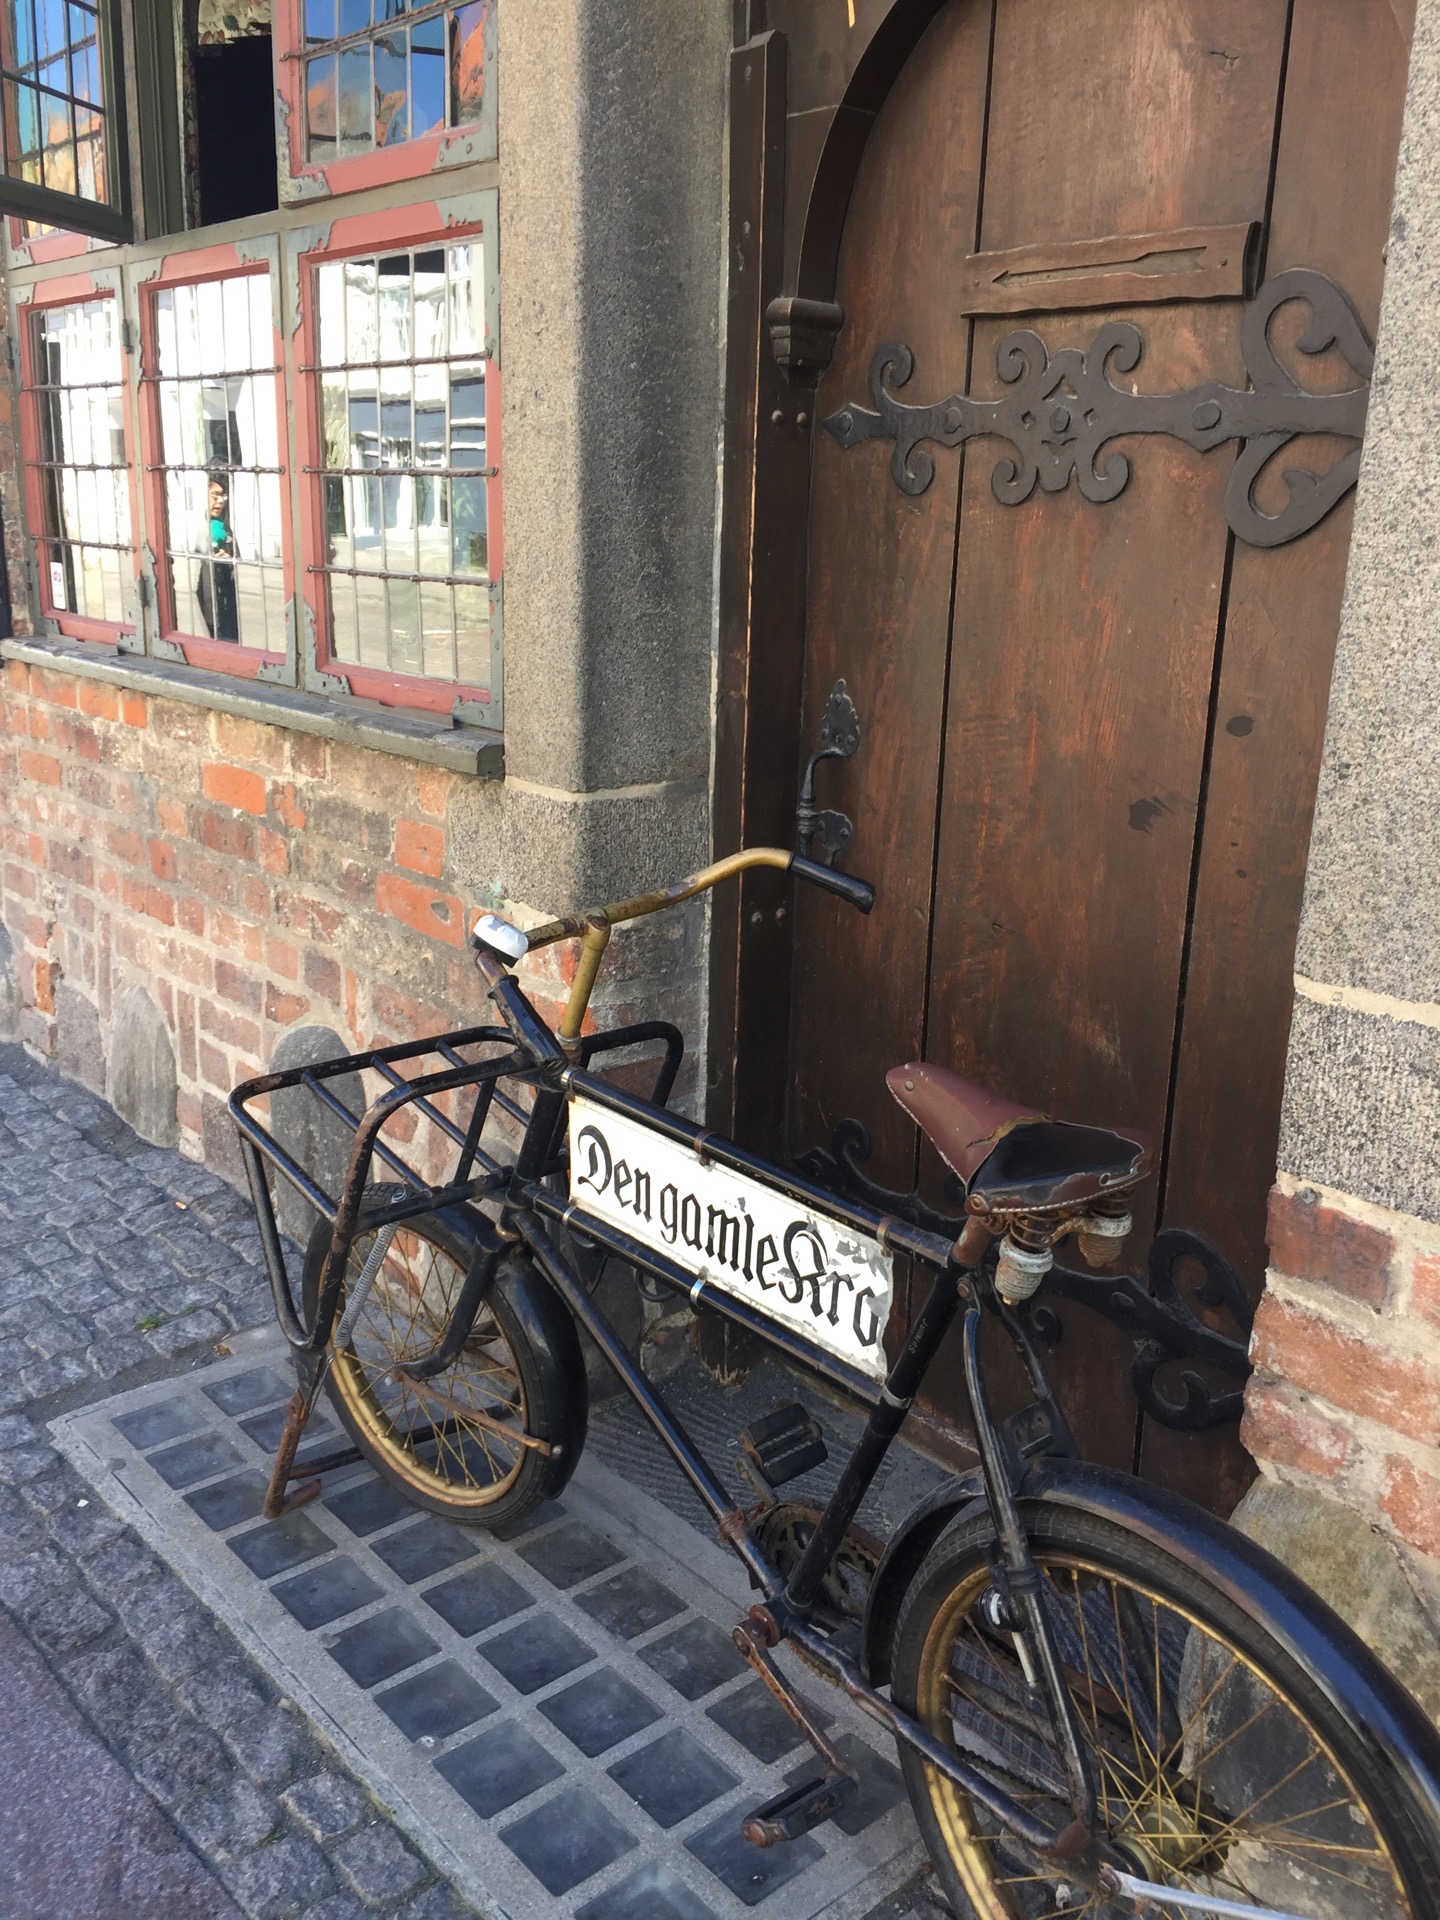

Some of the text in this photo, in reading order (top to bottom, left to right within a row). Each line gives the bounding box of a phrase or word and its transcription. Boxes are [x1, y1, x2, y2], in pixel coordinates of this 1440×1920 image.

[577, 1124, 880, 1348] Den gamle Kro
